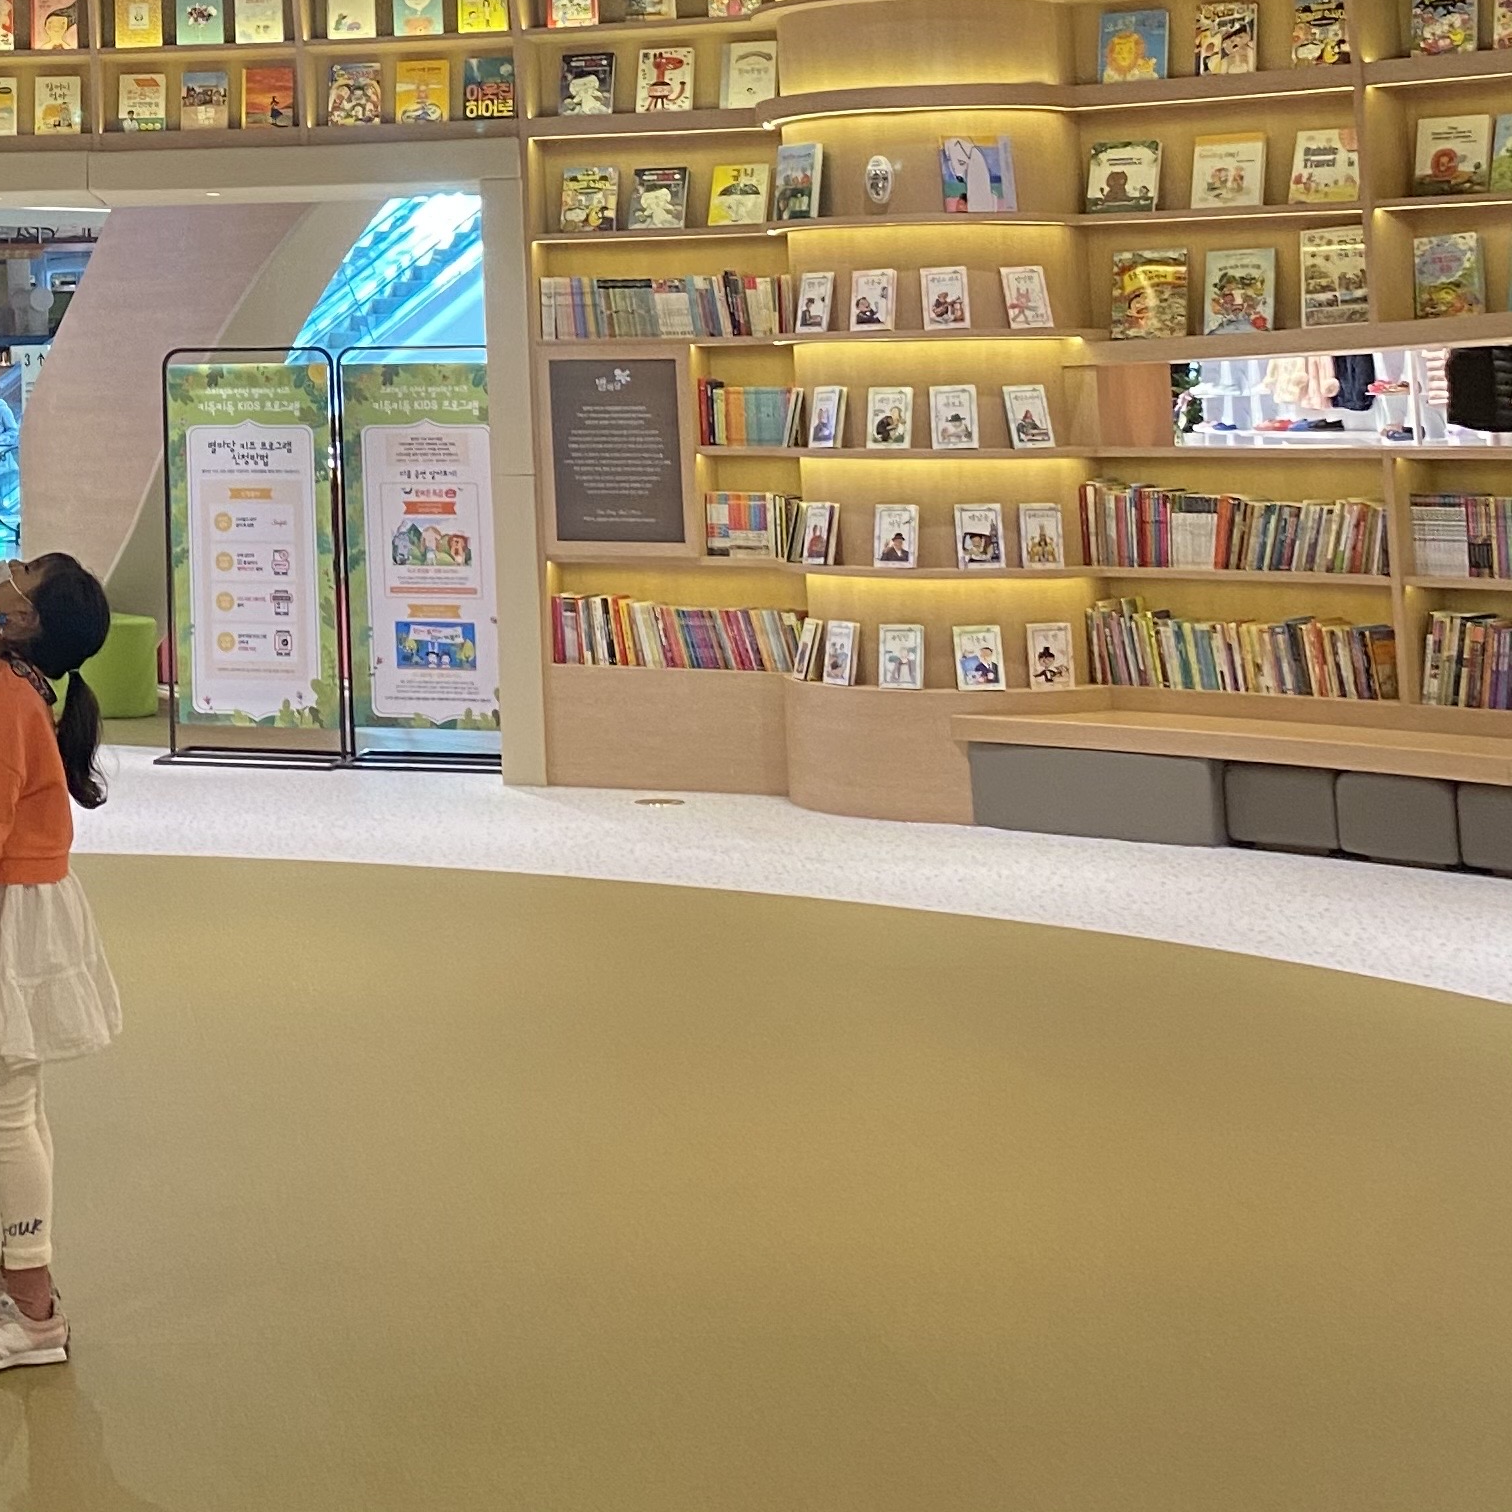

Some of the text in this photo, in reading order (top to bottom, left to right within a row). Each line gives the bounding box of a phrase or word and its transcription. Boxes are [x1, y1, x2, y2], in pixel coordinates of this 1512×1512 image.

[465, 81, 513, 100] 이웃집
[465, 99, 513, 118] 히어로
[24, 354, 31, 366] 3
[237, 401, 260, 411] KIDS
[264, 401, 300, 417] 프로그램
[414, 401, 437, 411] KIDS
[442, 400, 480, 416] 프로그램
[208, 440, 292, 454] 별마당 키즈 프로그램
[232, 452, 269, 467] 신청방법
